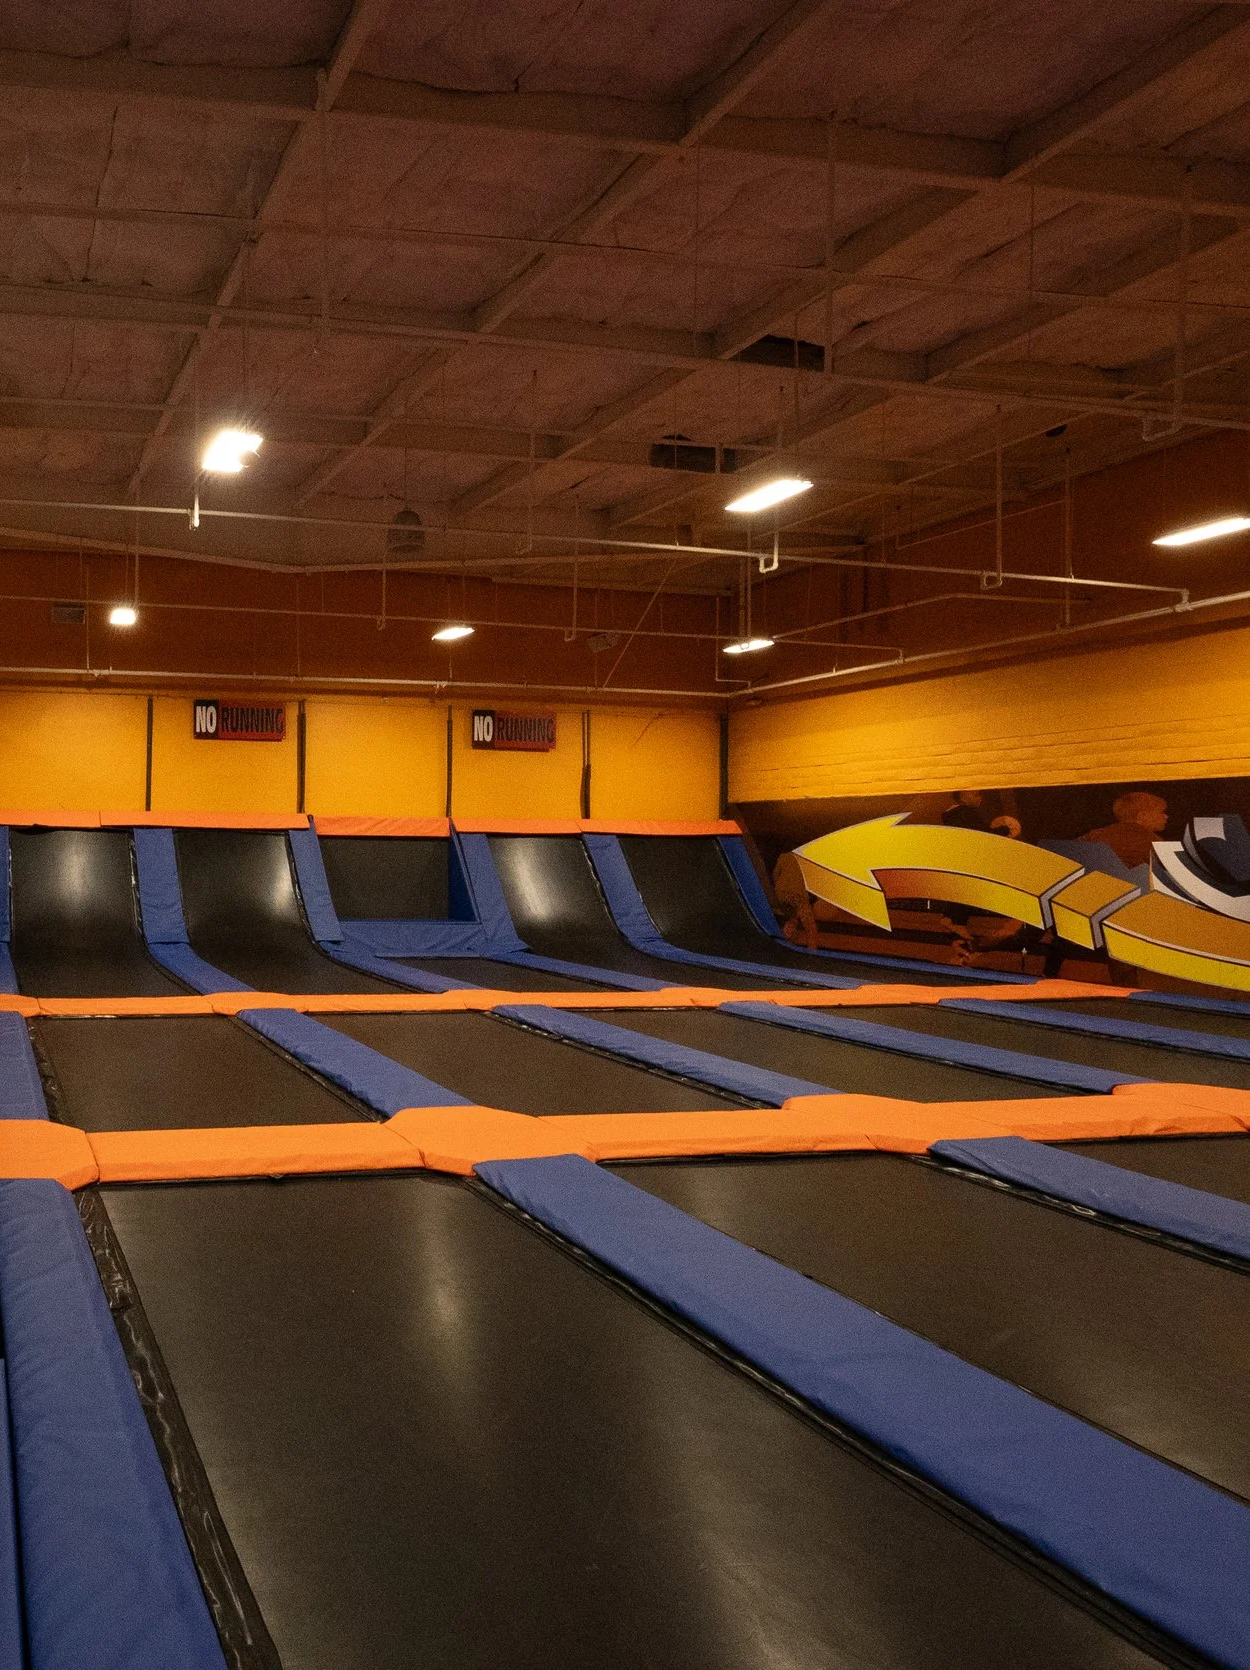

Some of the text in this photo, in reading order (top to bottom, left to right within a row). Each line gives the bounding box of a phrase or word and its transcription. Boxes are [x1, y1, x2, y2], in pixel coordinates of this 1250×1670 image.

[195, 705, 284, 733] NO RUNNING
[473, 715, 554, 742] NO RUNNING
